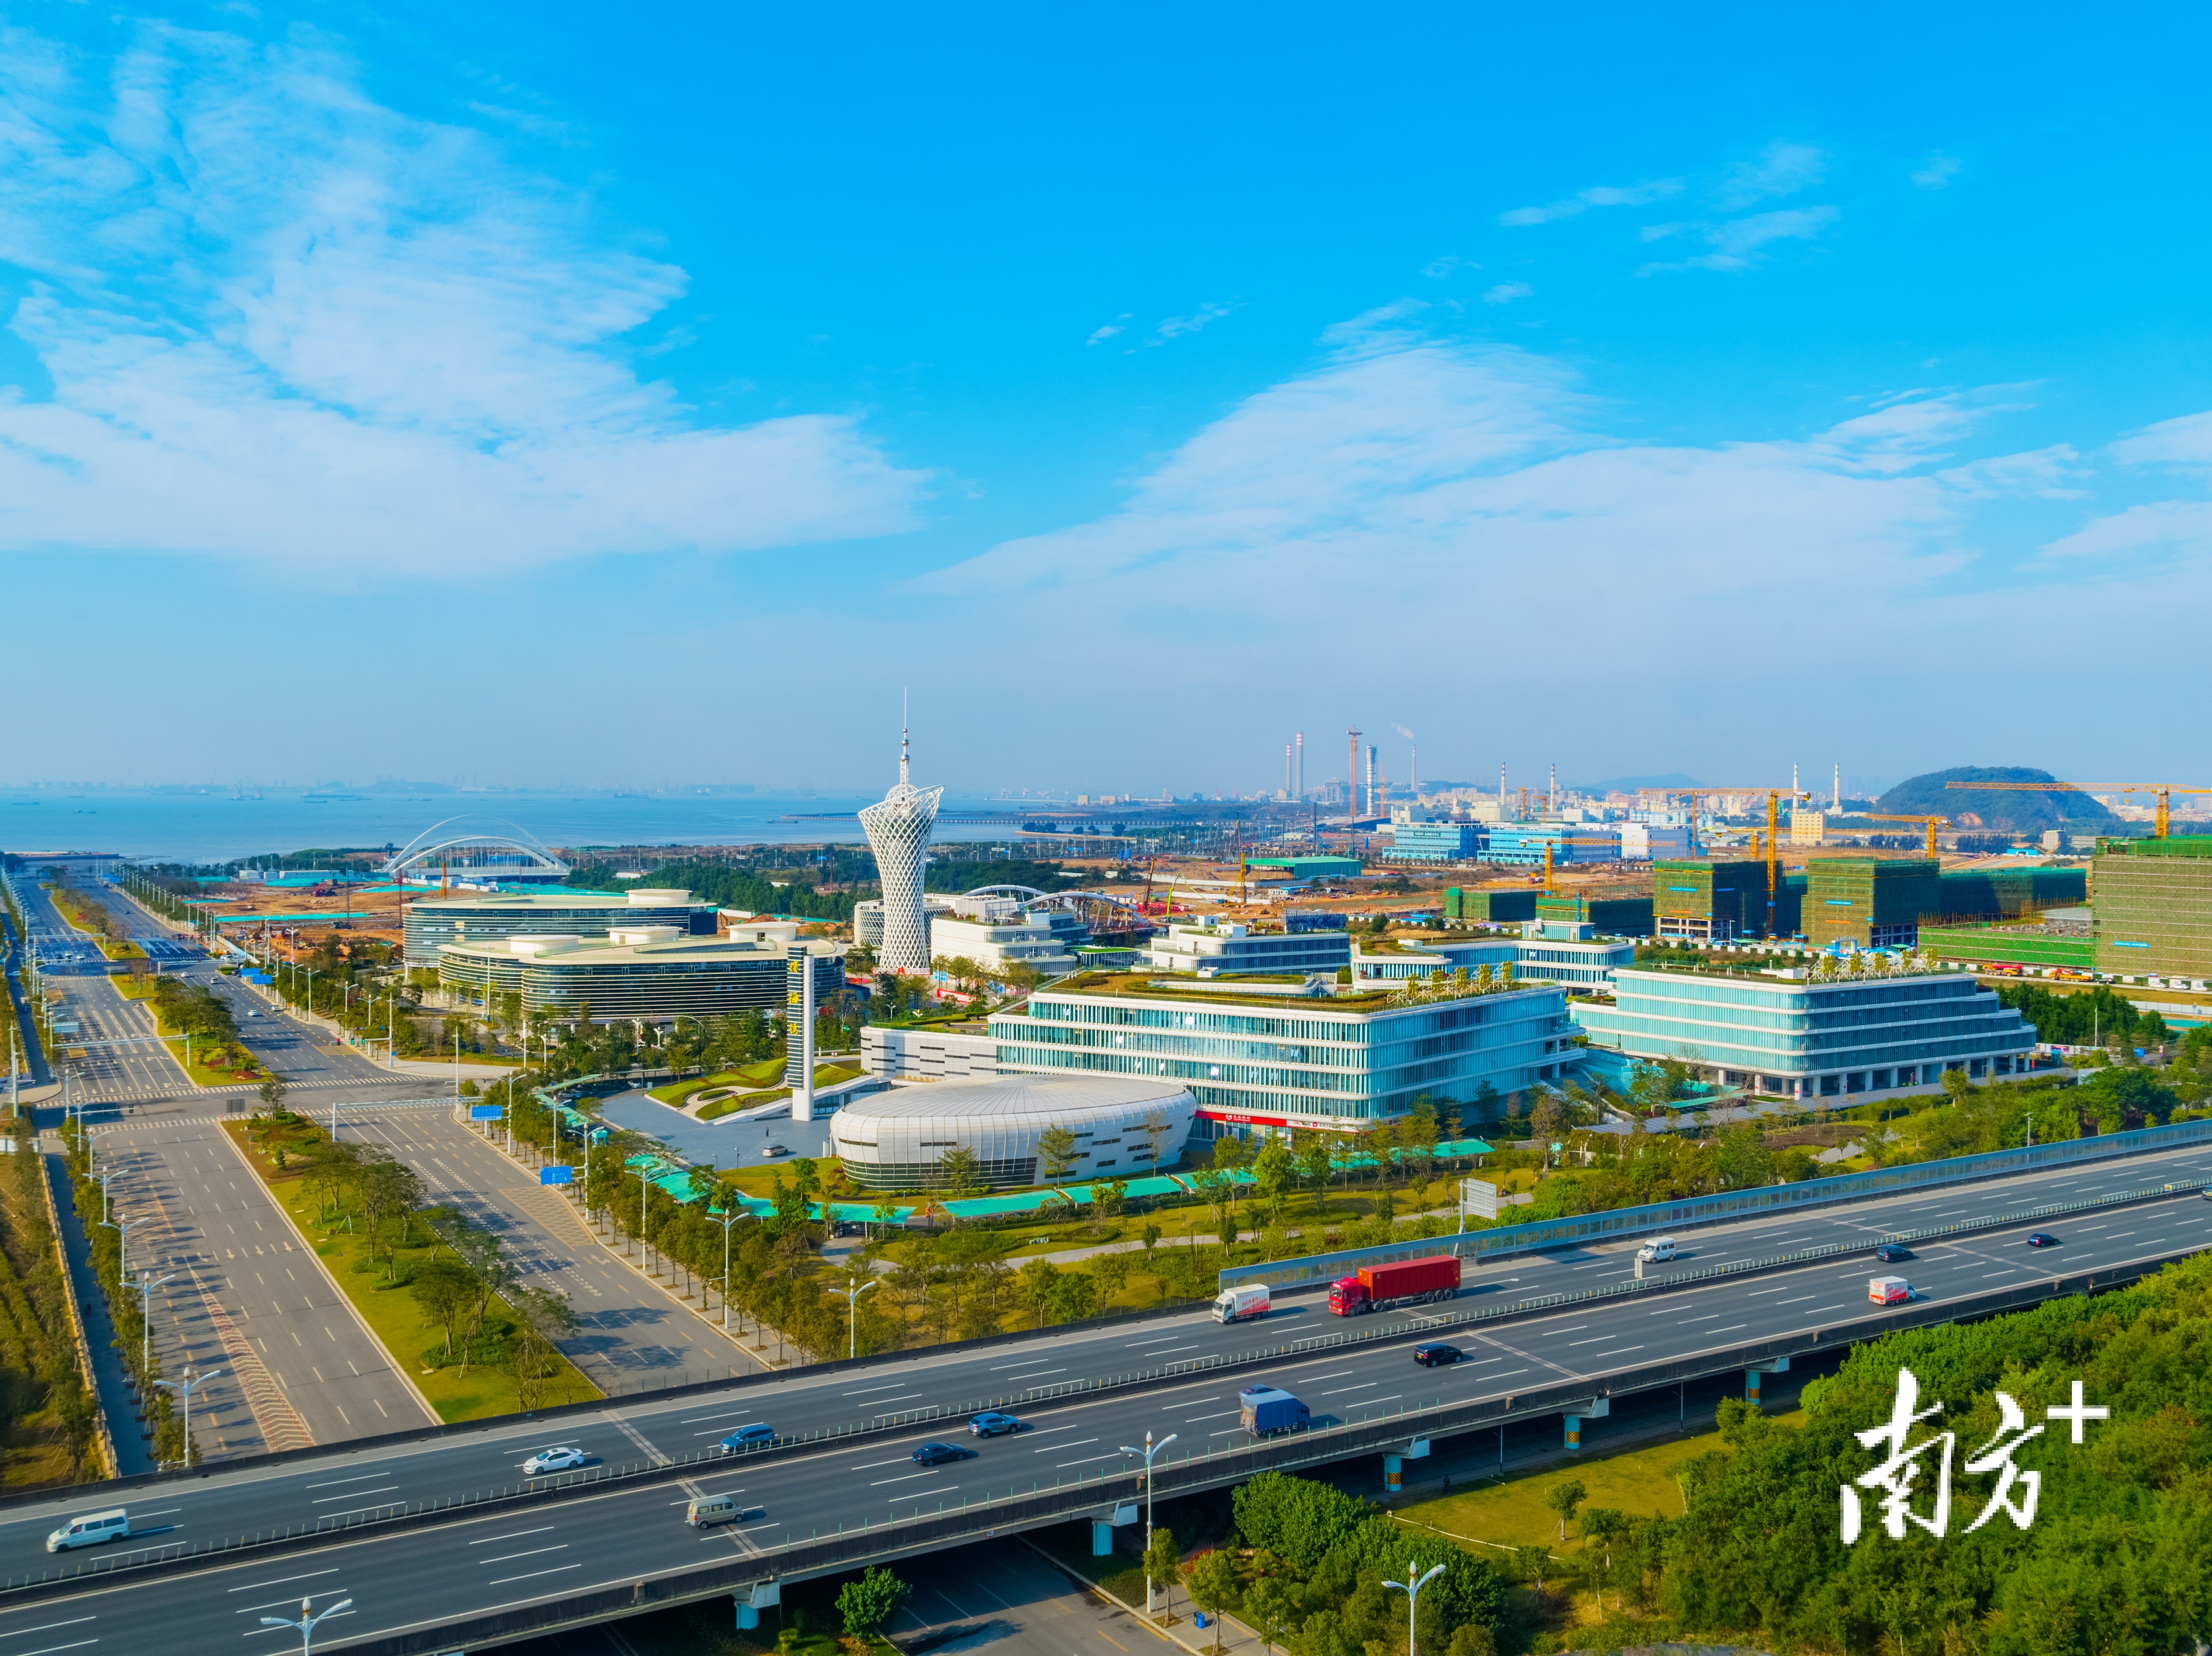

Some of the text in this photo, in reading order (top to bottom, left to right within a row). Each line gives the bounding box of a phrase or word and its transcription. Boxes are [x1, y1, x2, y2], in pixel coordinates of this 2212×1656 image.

[1821, 948, 1938, 974] 筑就新梦想
[1406, 960, 1513, 997] 东莞滨海湾
